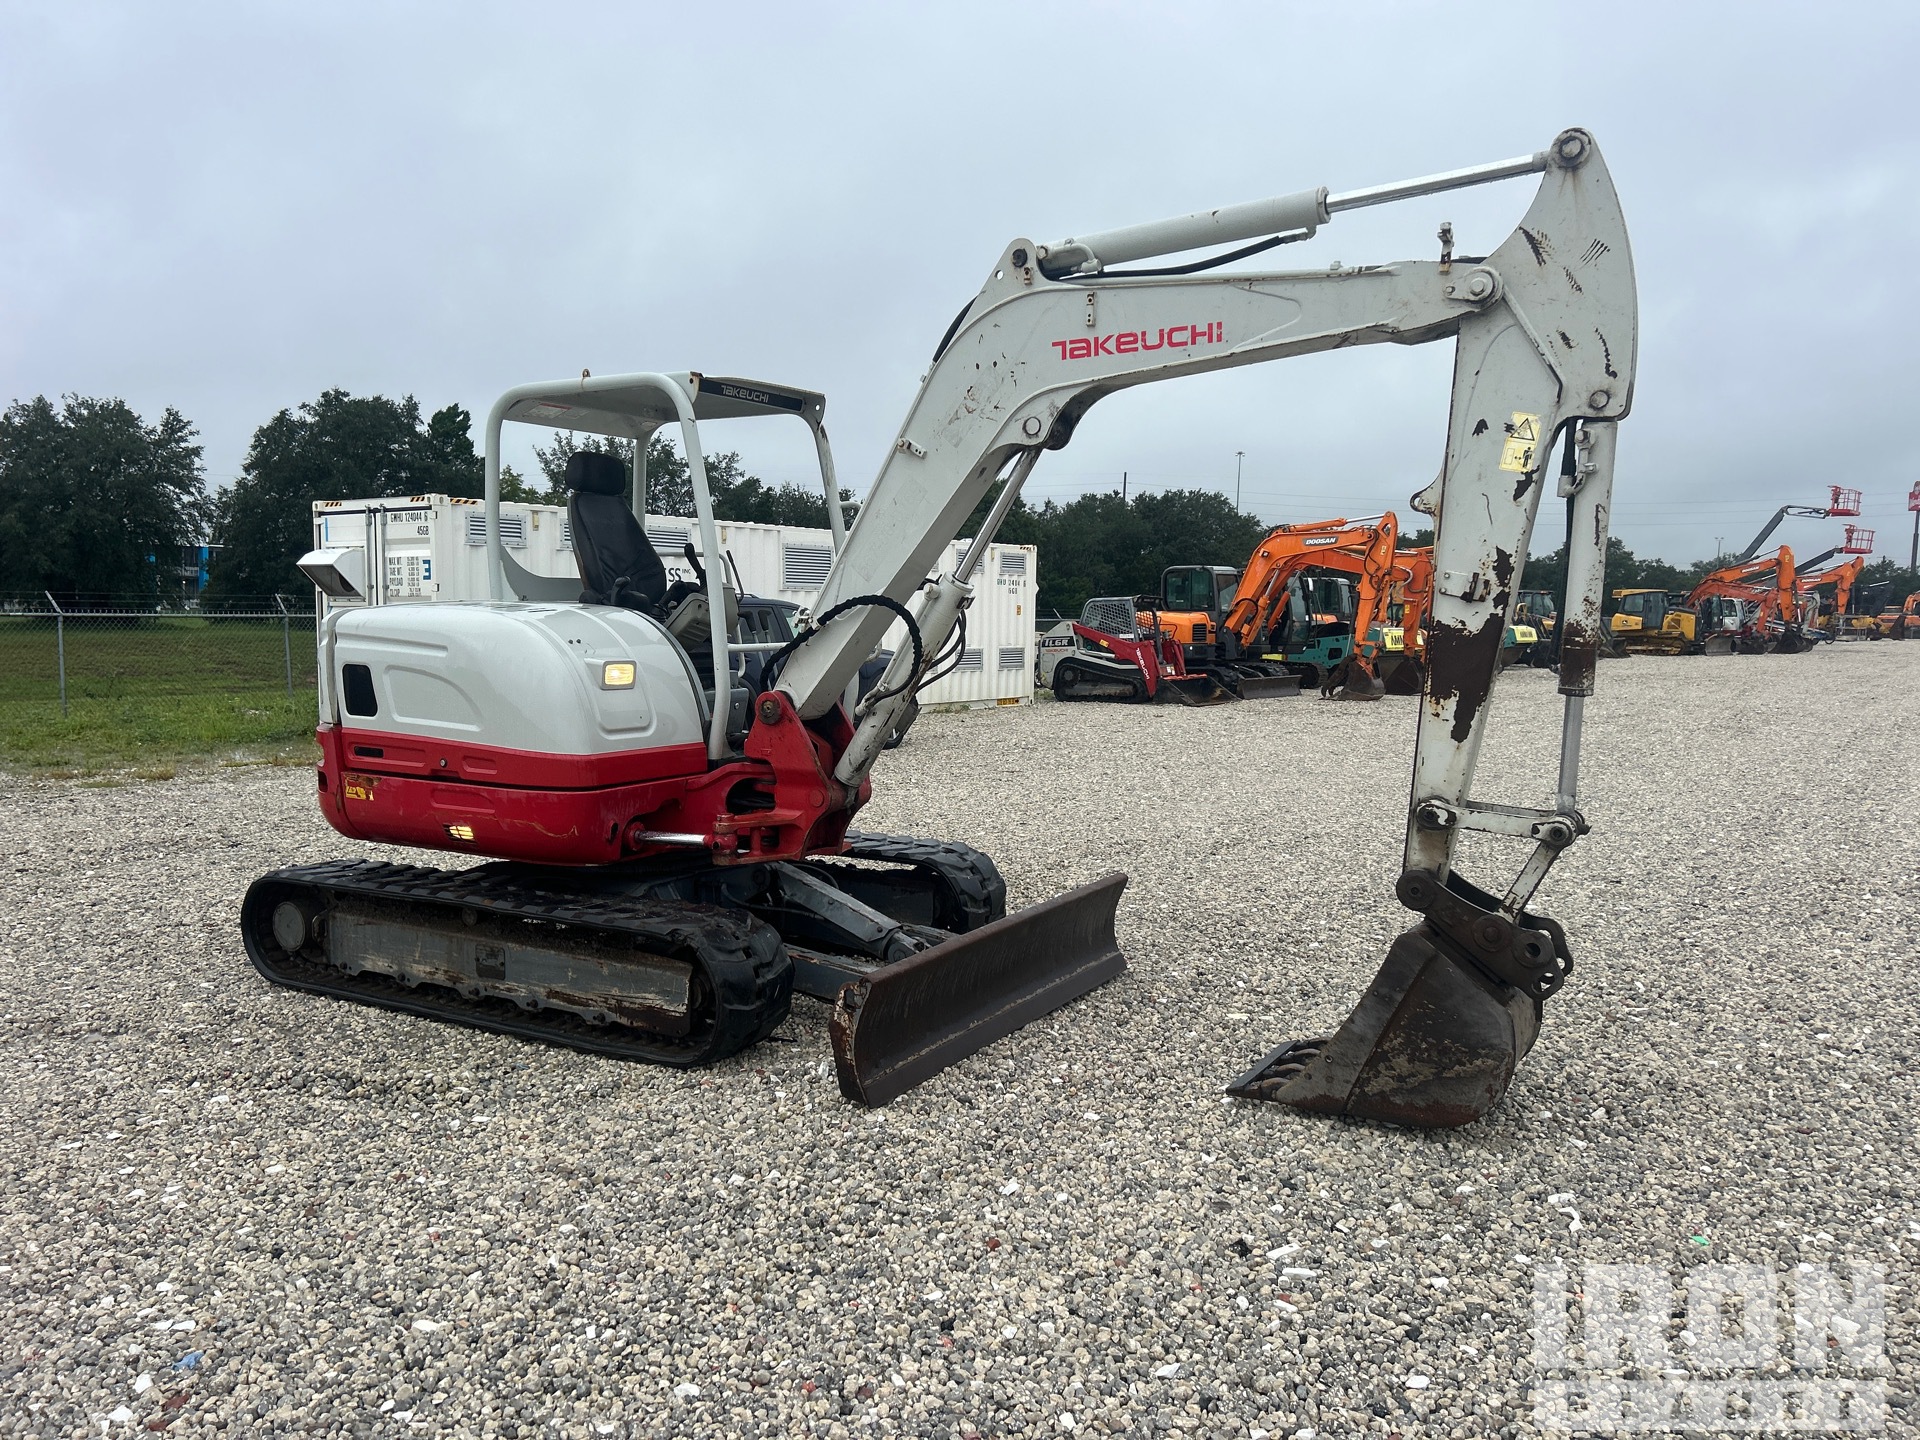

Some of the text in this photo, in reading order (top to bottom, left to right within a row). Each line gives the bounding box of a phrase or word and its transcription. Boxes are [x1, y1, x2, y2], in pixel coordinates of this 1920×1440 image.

[1051, 321, 1223, 361] TAKEUCHI
[720, 385, 769, 403] TAKEUCHI
[1305, 537, 1336, 545] DOOSAN
